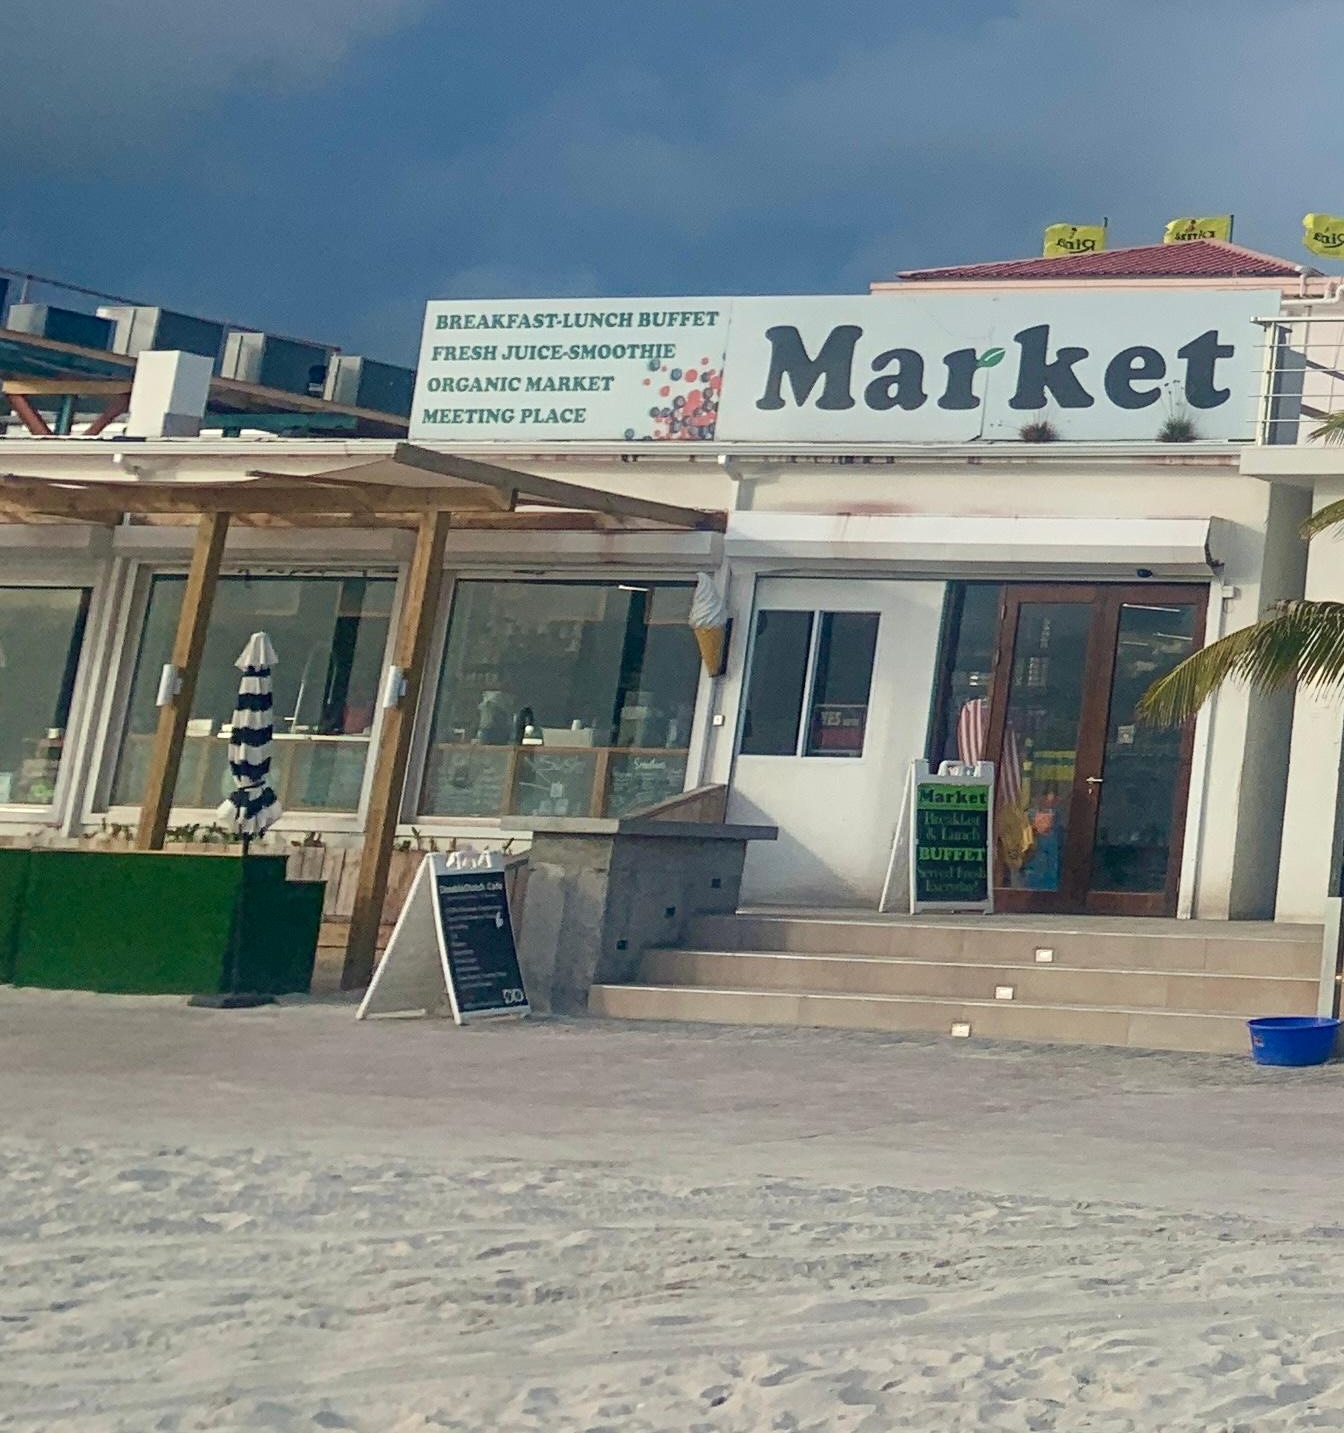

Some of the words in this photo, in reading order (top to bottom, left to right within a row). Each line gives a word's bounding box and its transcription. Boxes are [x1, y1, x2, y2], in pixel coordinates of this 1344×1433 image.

[435, 312, 633, 330] BREAKFAST-LUNCH
[638, 311, 719, 328] BUFFET
[431, 345, 497, 361] FRESH
[501, 343, 676, 360] JUICE-SMOOTHIE
[755, 324, 1235, 410] Market
[427, 376, 522, 393] ORGANIC
[525, 375, 615, 392] MARKET
[421, 408, 516, 424] MEETING
[519, 407, 587, 424] PLACE
[919, 790, 987, 804] Market
[920, 848, 985, 861] BUFFET
